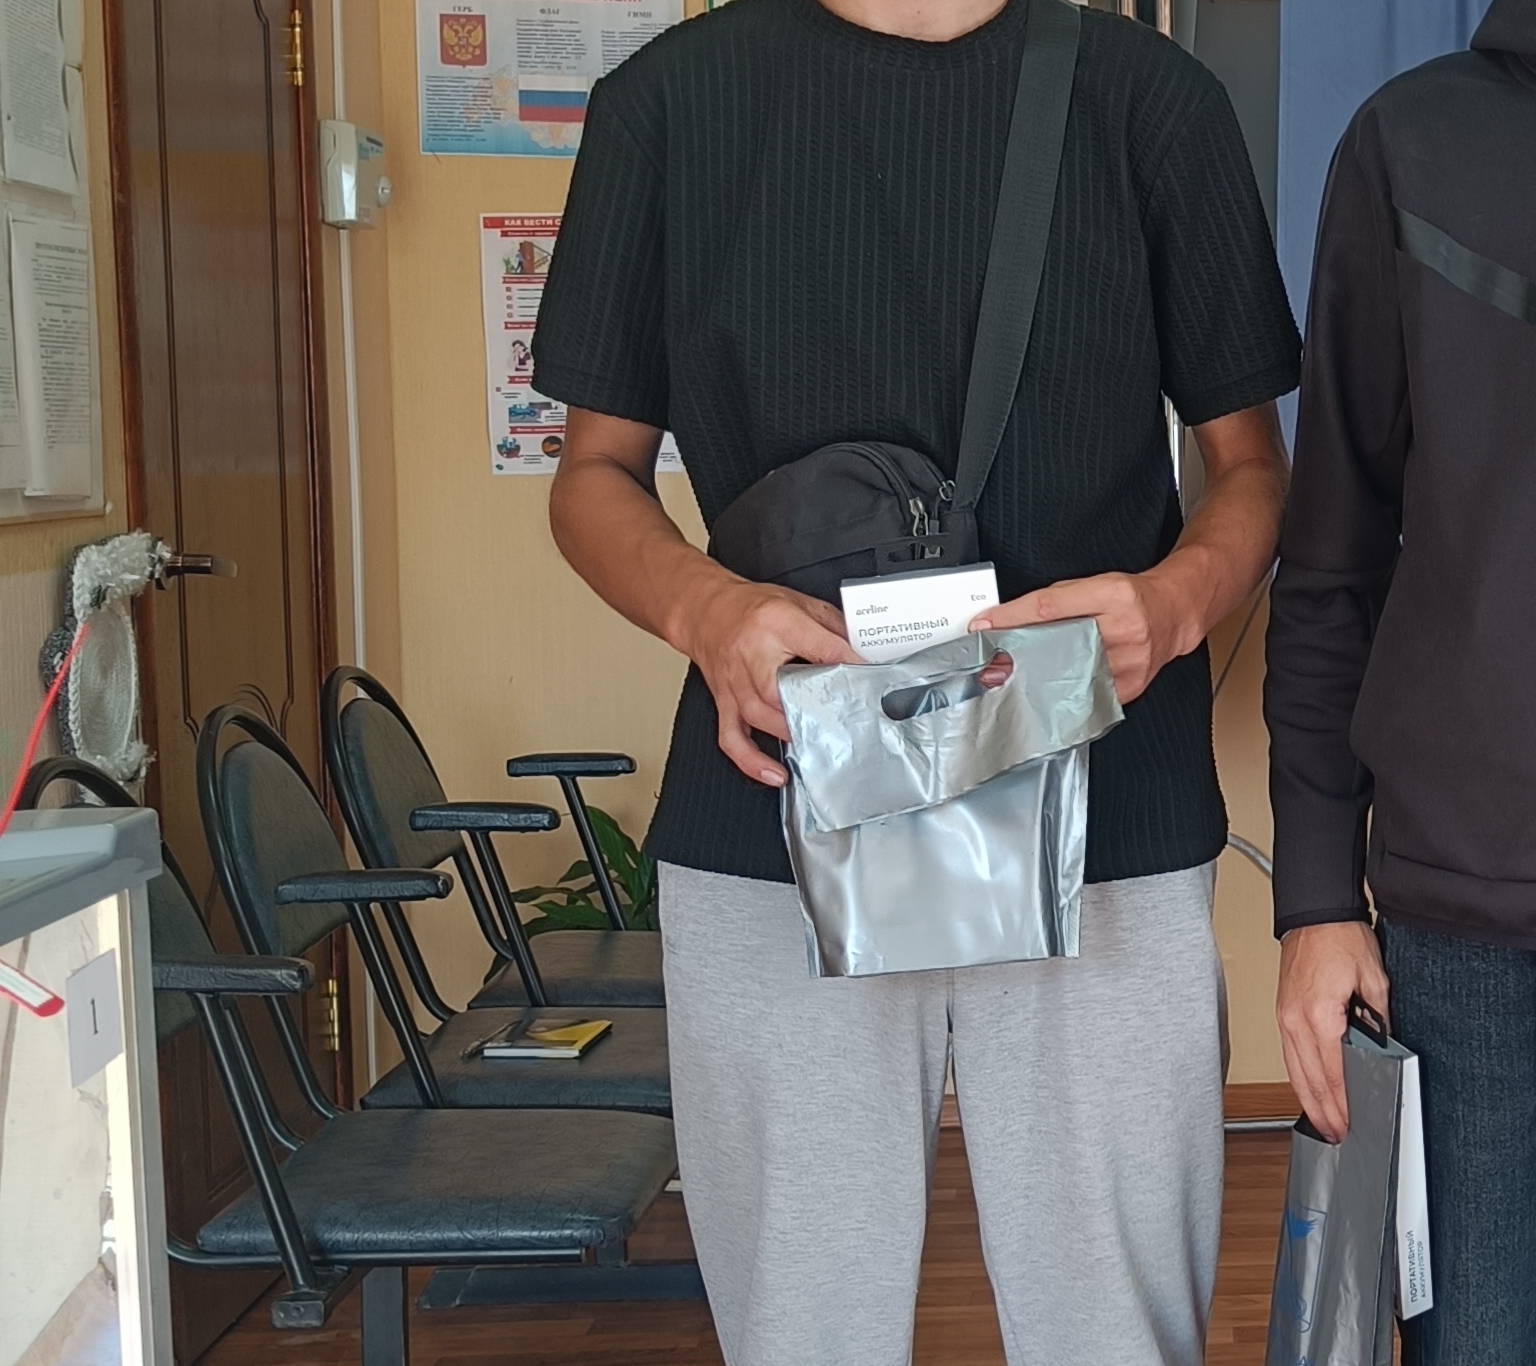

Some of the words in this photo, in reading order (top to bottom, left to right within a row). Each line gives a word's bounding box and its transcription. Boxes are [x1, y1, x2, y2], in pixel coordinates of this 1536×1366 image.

[858, 617, 949, 638] ПОРТАТИВНЫЙ
[860, 632, 933, 648] АККУМУЛЯТОР
[91, 997, 99, 1036] 1
[1405, 1230, 1418, 1303] ПОРТАТИВНЫЙ
